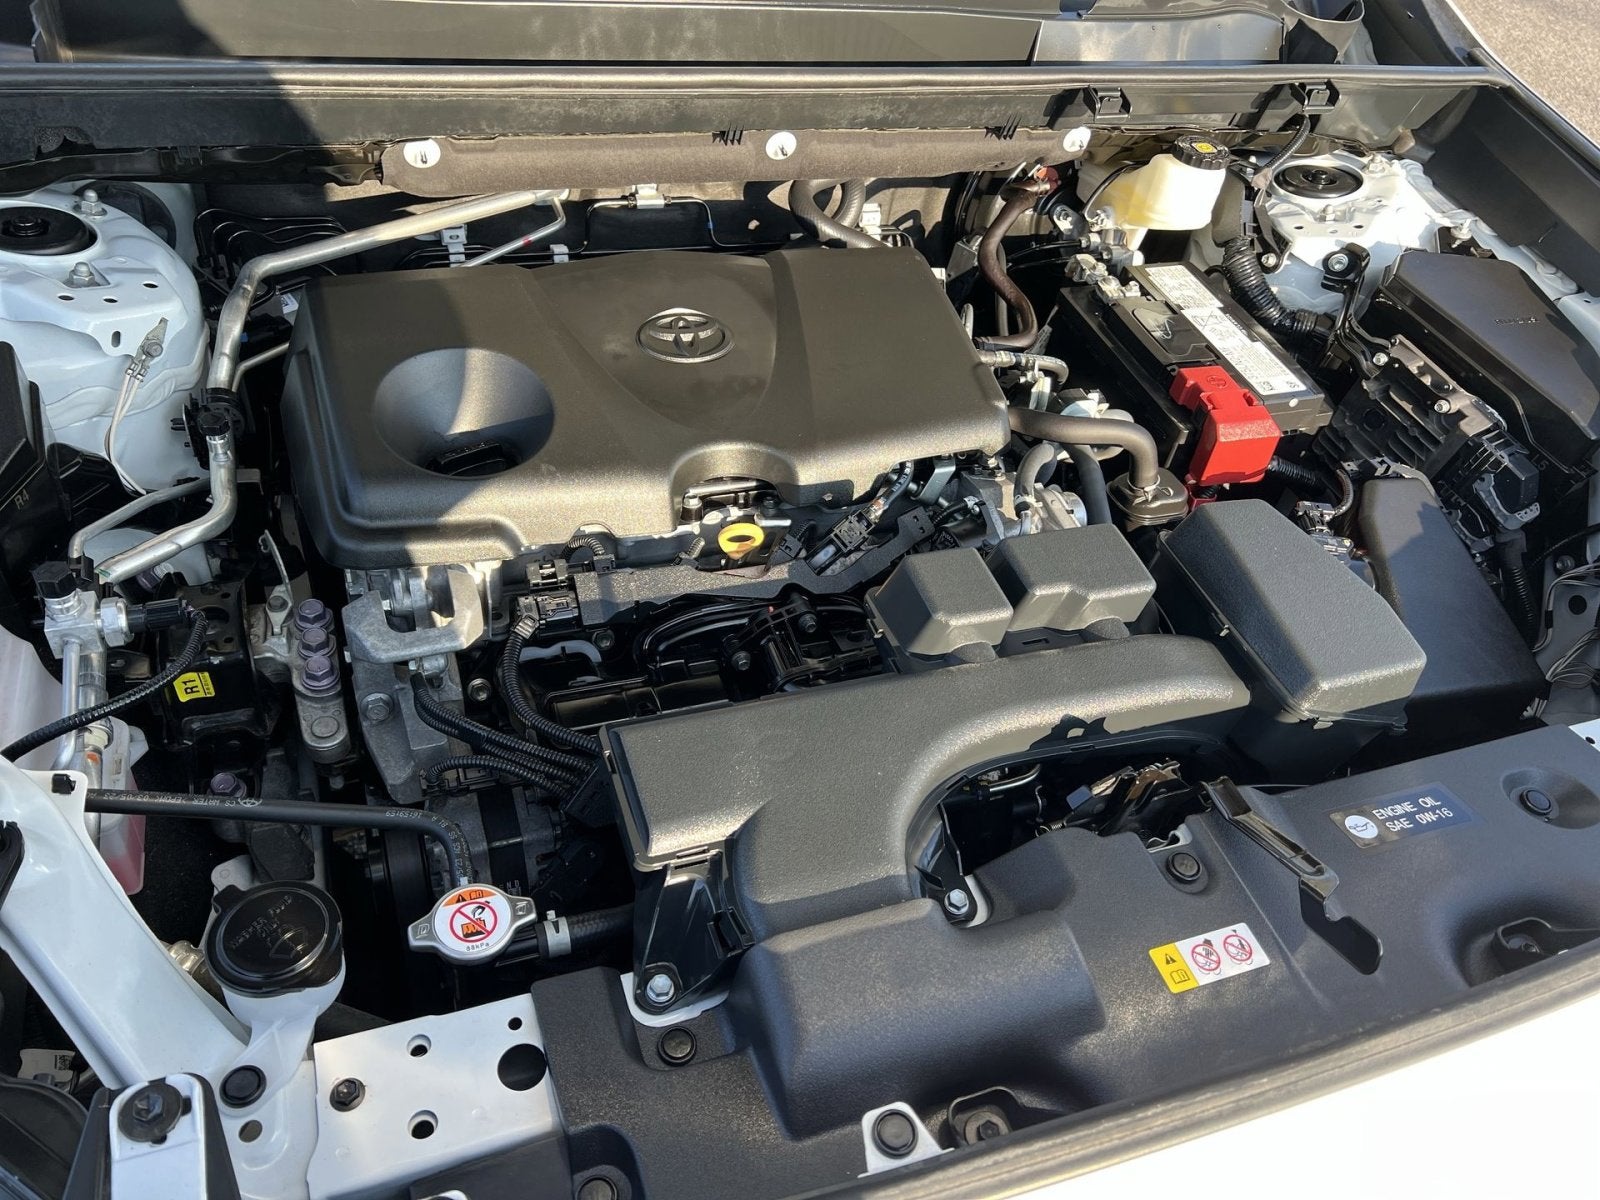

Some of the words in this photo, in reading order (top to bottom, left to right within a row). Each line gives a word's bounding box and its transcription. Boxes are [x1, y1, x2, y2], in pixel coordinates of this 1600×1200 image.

[14, 488, 30, 510] R4
[182, 678, 201, 695] R1
[1372, 801, 1418, 820] ENGINE
[1418, 796, 1442, 809] OIL
[1385, 817, 1414, 832] SAE
[1415, 807, 1454, 825] 0W-16
